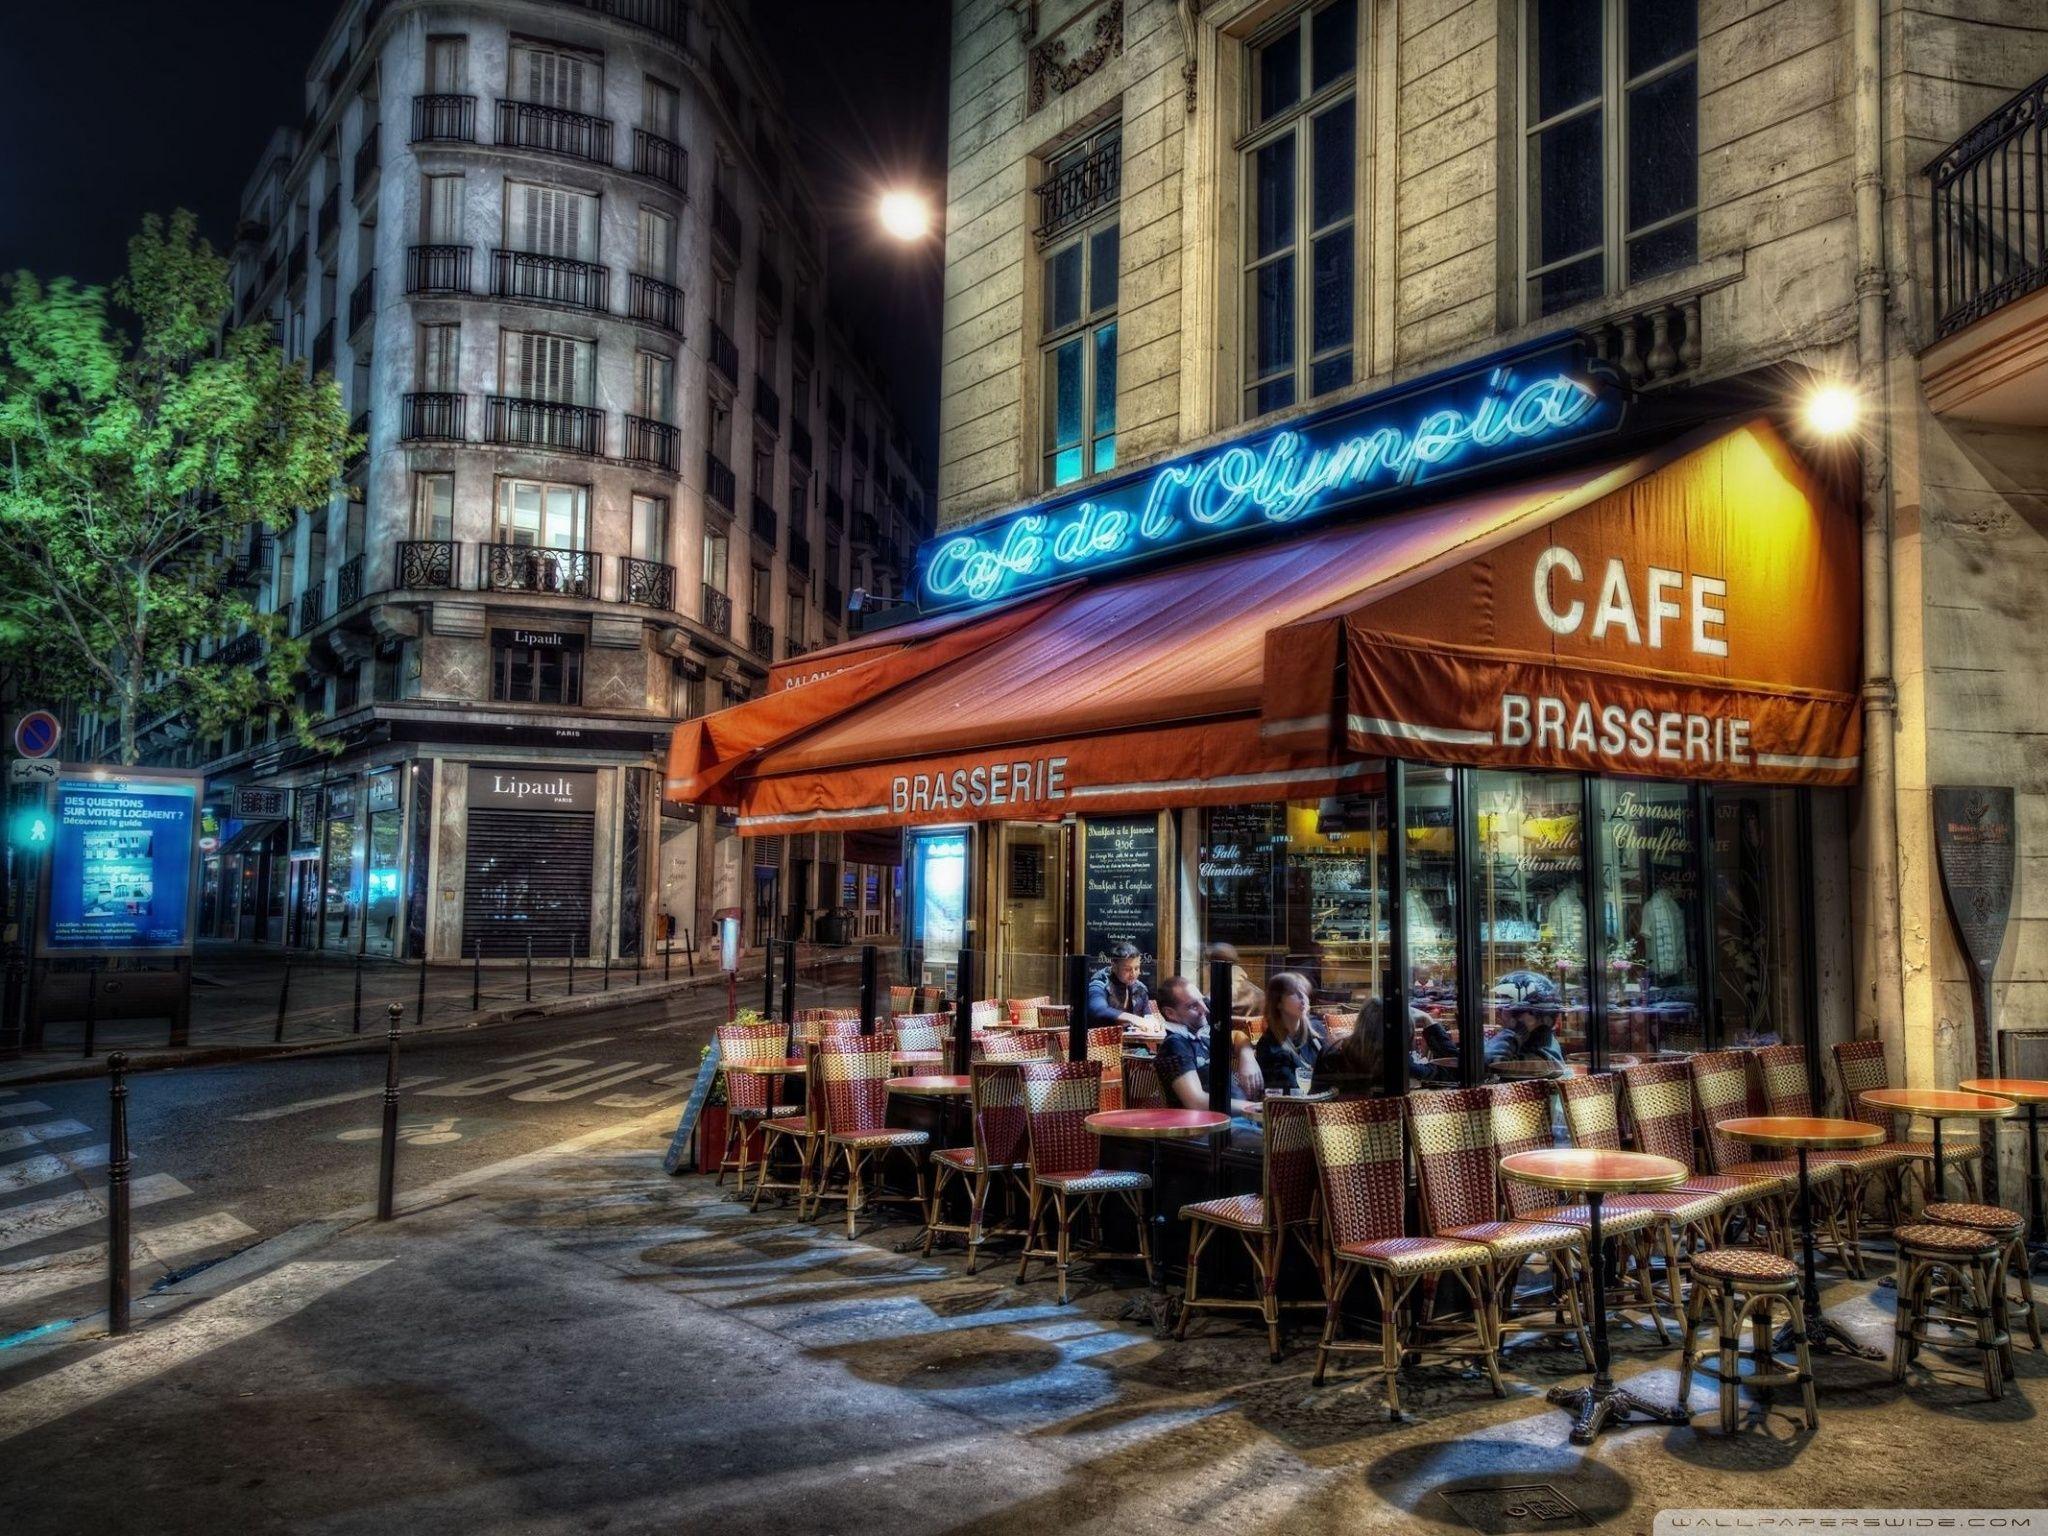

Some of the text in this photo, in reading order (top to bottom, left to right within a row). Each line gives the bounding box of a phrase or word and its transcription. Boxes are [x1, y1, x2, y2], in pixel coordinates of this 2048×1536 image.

[926, 516, 1044, 598] Café
[1053, 503, 1127, 563] de
[1534, 546, 1728, 657] CAFE
[514, 631, 562, 645] Lipault
[1502, 694, 1751, 765] BRASSERIE
[494, 775, 573, 798] Lipault
[892, 757, 1068, 813] BRASSERIE
[63, 807, 184, 820] SUR VOTRE LOGEMENT ?
[64, 797, 144, 808] DES QUESTIONS
[1615, 791, 1682, 820] Terrasse
[63, 816, 143, 828] Découvrez le guide
[1212, 844, 1240, 859] Salle
[1613, 823, 1688, 861] Chauffée
[1516, 854, 1583, 872] Climatis
